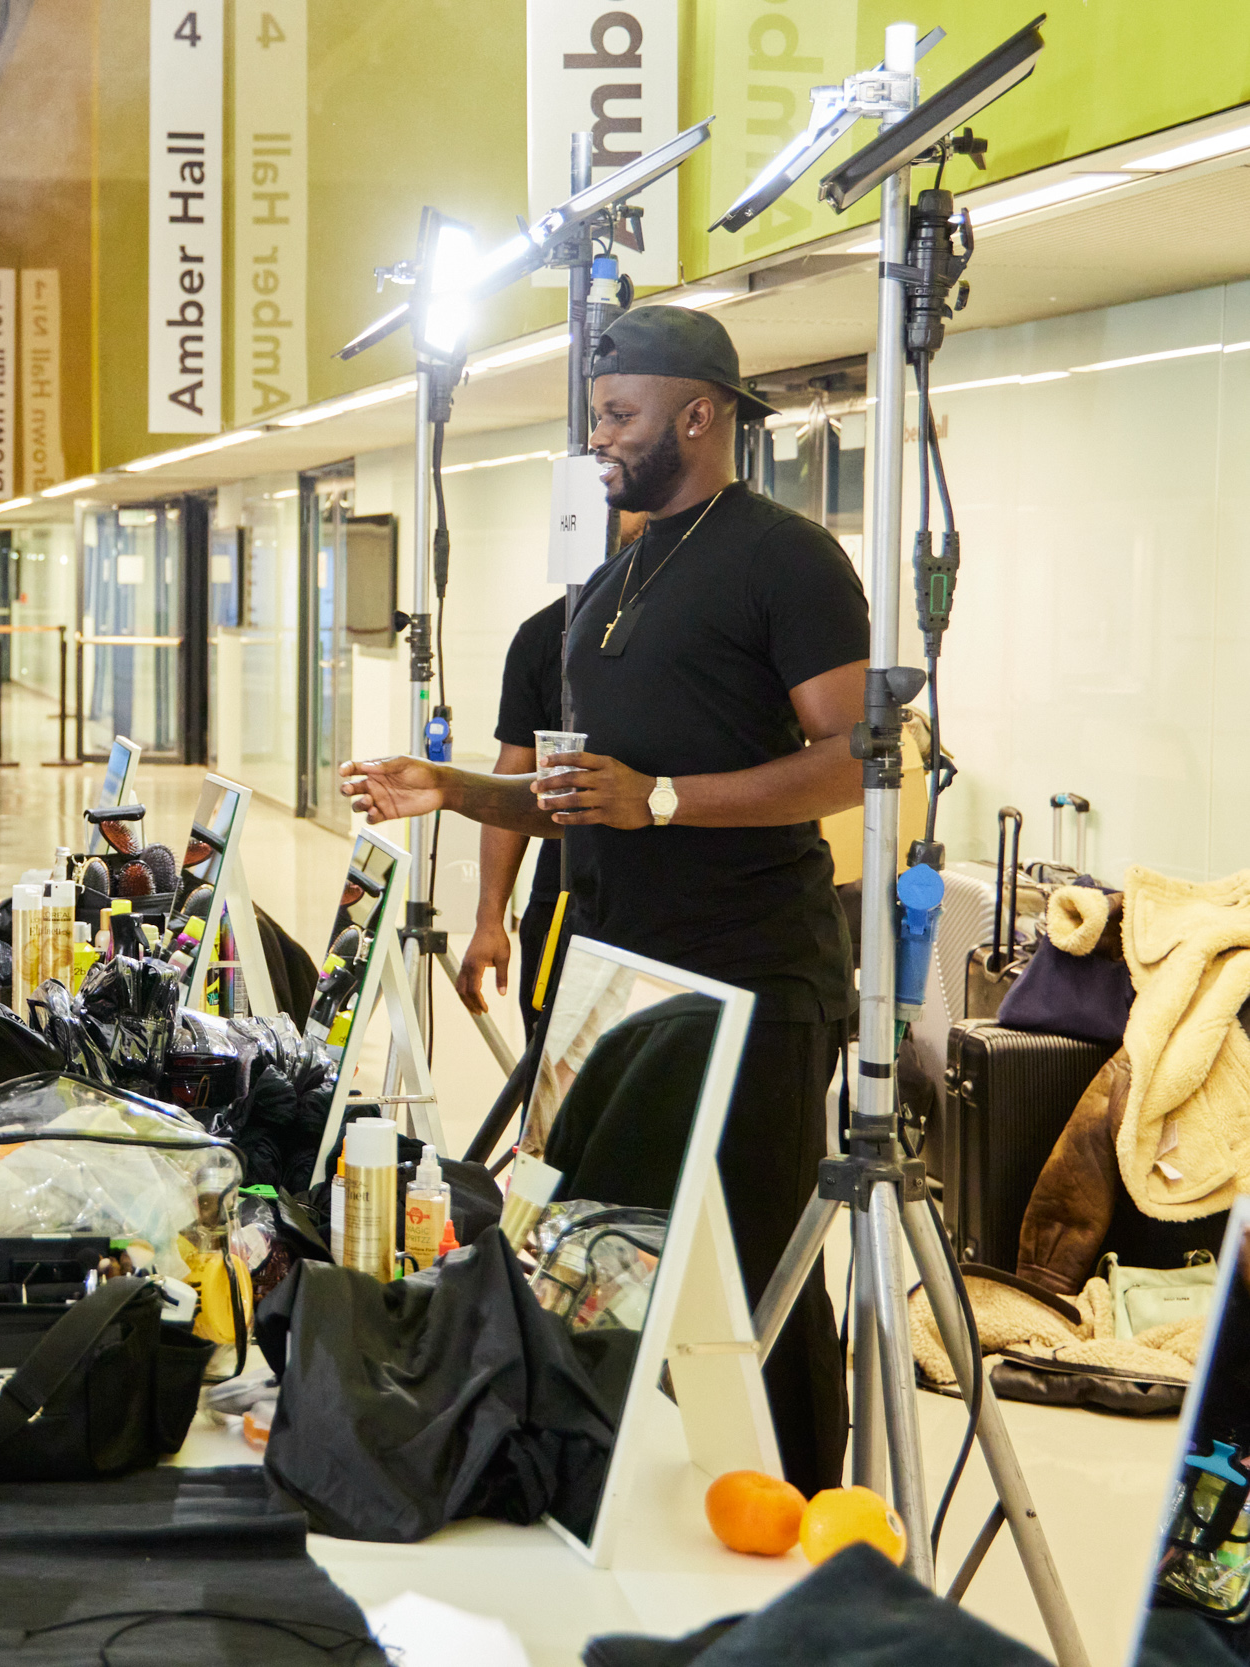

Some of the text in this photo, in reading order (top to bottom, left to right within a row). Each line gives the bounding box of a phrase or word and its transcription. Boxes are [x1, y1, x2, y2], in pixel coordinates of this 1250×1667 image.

[165, 12, 205, 417] Amber Hall 4
[560, 514, 577, 532] HAIR
